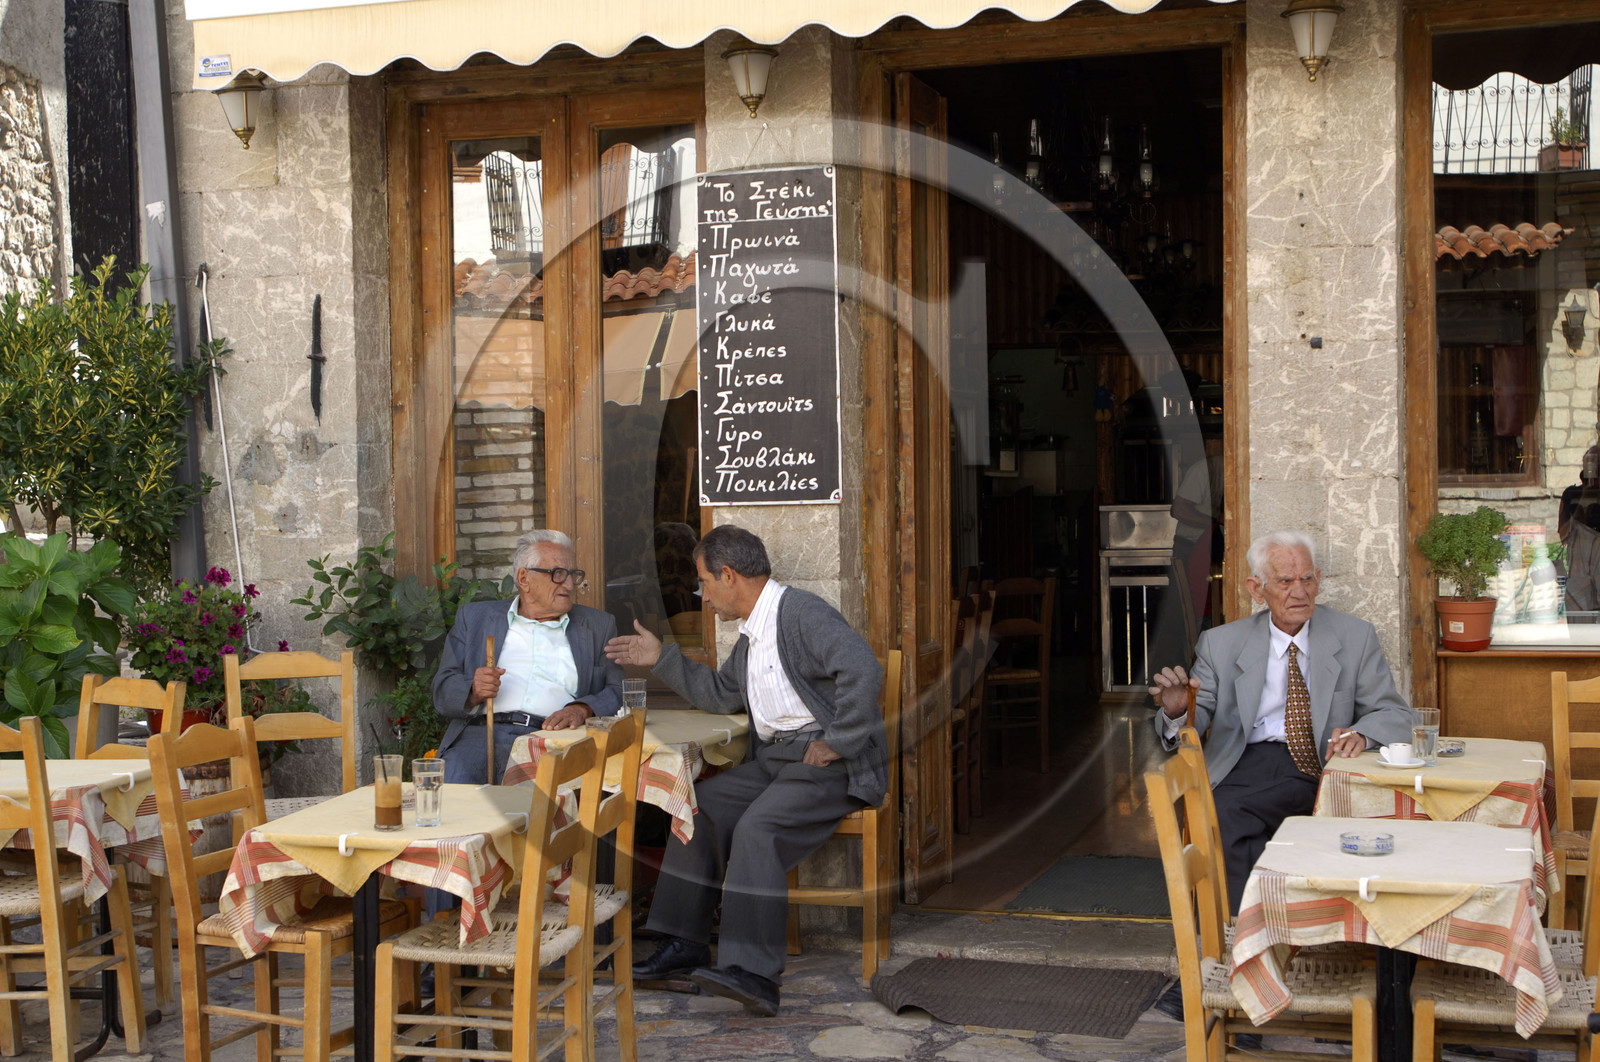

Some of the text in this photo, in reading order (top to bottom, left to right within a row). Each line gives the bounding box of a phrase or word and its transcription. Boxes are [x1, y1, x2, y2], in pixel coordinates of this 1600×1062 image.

[748, 180, 815, 200] Στέκι
[703, 208, 738, 223] της
[710, 224, 800, 259] Πρωινά
[709, 254, 800, 287] Παγωτά
[714, 280, 772, 305] Καφέ
[714, 310, 776, 334] Γλυκά
[716, 335, 787, 370] Κρέπες
[715, 363, 784, 388] Πίτσα
[716, 417, 763, 452] Γύρο
[715, 445, 816, 469] Σουβλάκι
[716, 470, 819, 492] Ποικιλίες
